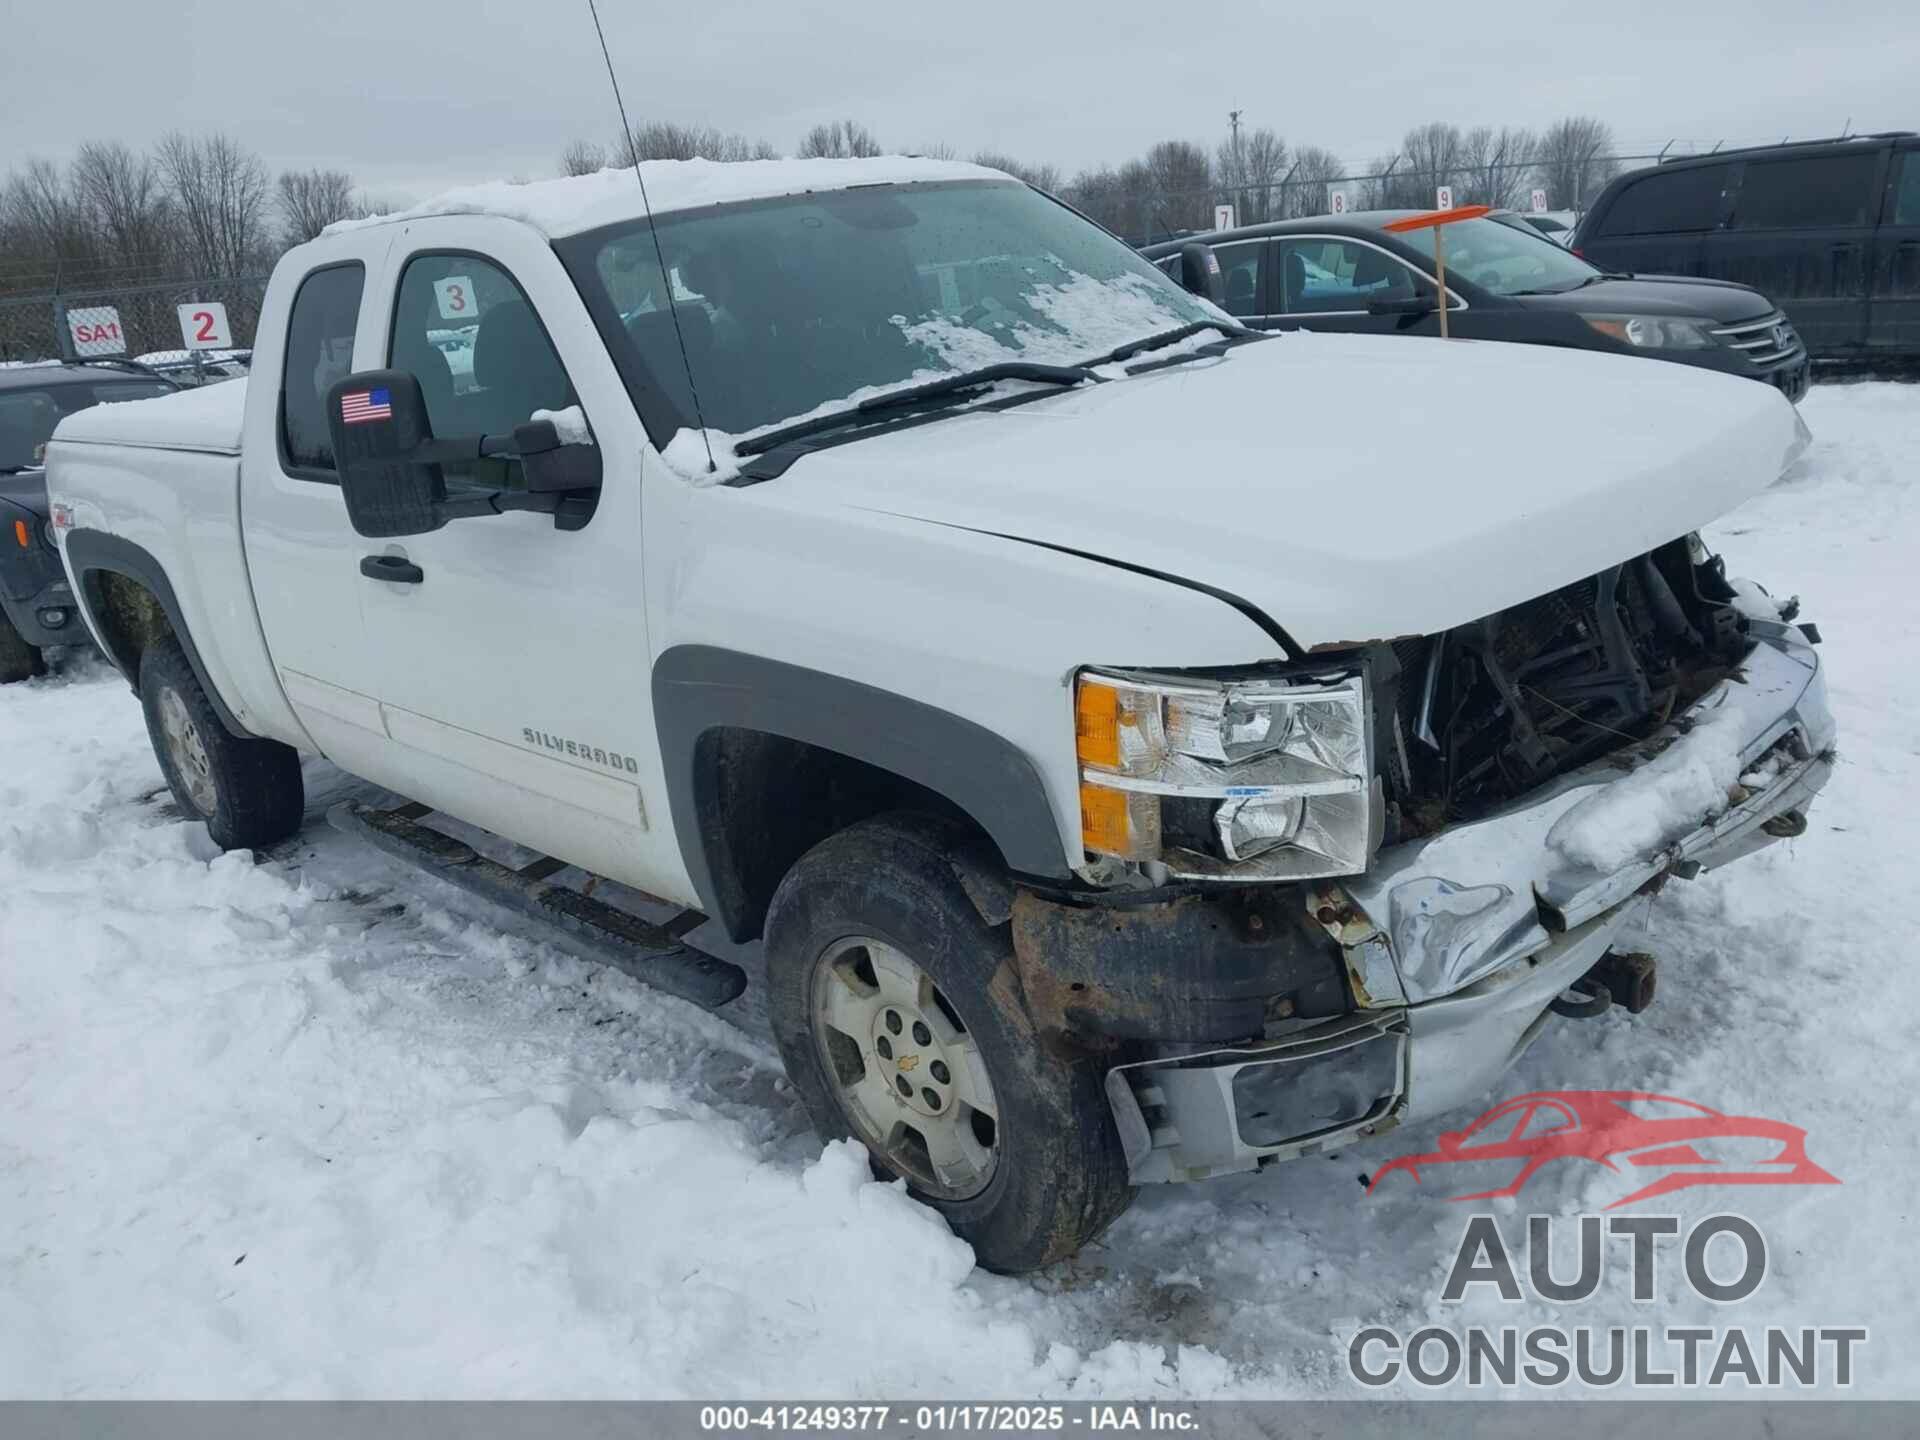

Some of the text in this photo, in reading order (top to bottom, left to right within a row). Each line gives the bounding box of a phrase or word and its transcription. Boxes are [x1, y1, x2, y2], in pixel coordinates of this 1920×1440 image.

[1335, 195, 1343, 213] 8
[1440, 191, 1448, 207] 9
[1534, 194, 1545, 208] 10
[1221, 212, 1228, 230] 7
[446, 284, 465, 311] 3
[76, 323, 119, 343] SA1
[193, 312, 218, 342] 2
[523, 728, 638, 774] SILVERADO
